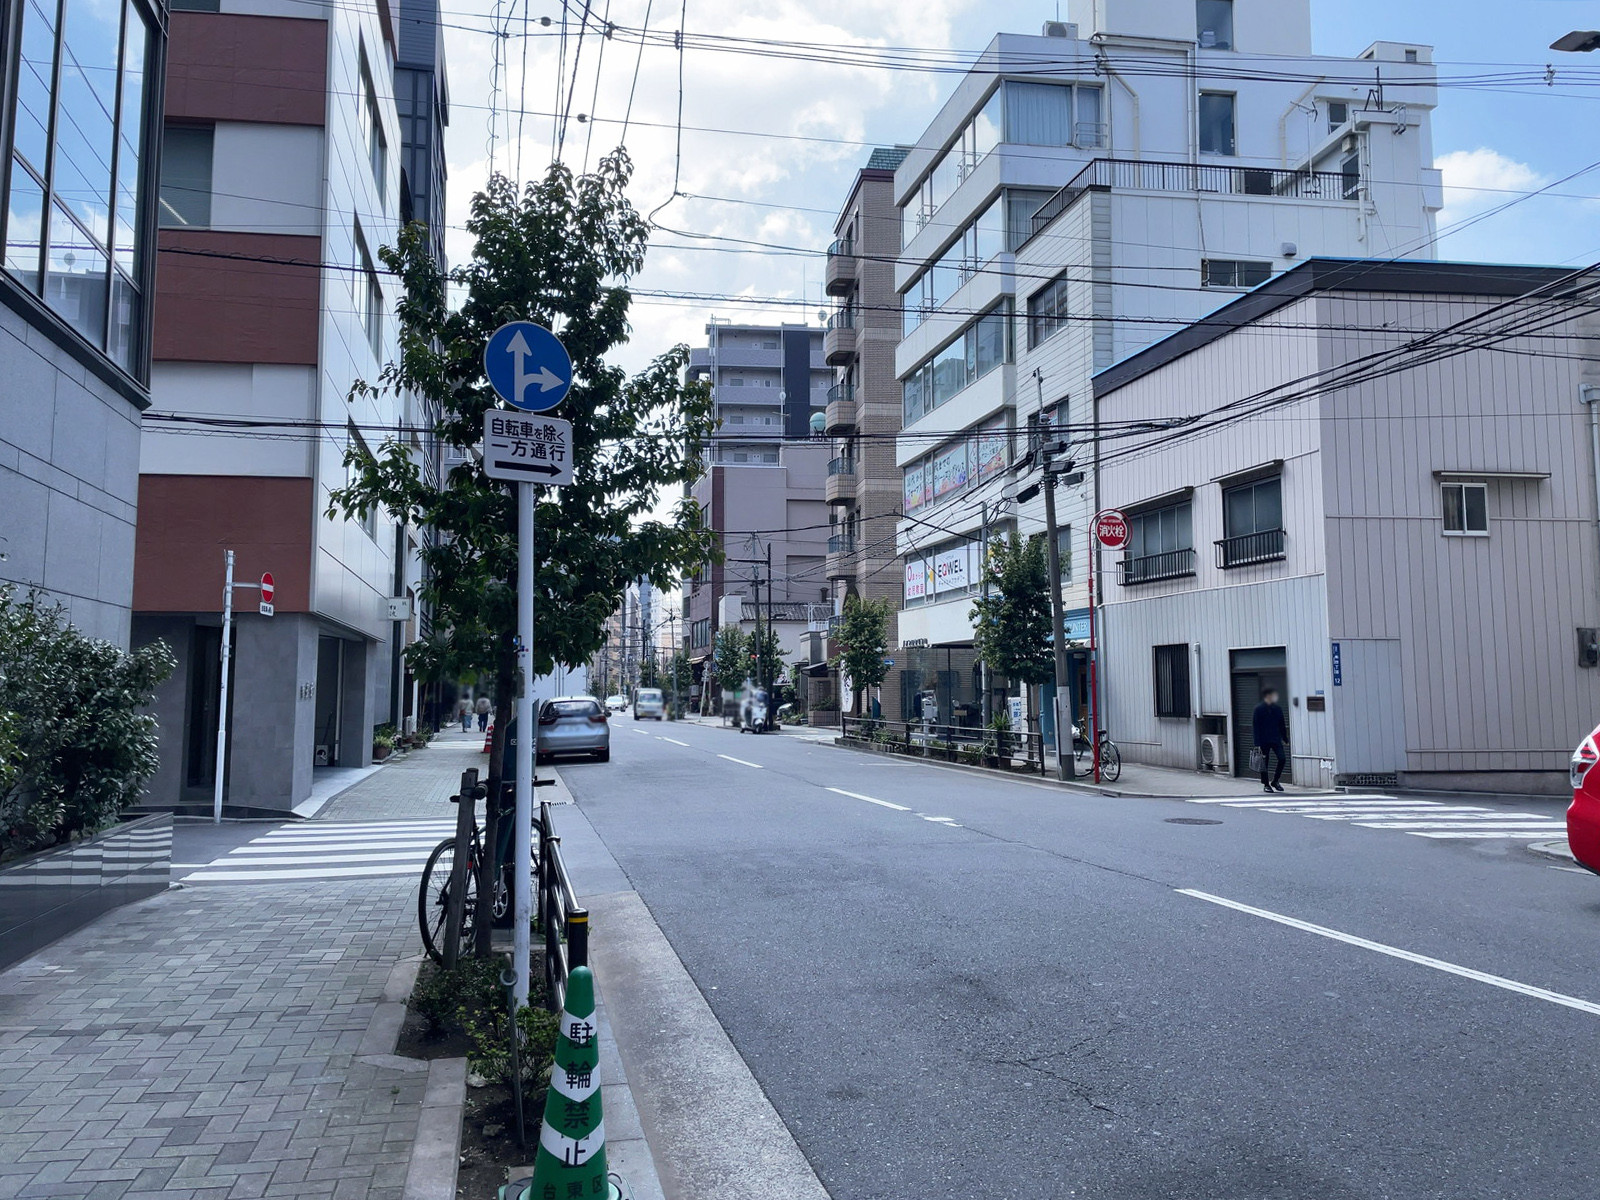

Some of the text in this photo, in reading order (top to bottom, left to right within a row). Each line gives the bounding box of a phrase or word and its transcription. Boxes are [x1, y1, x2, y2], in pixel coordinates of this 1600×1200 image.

[491, 418, 564, 443] 自転車を除く
[492, 440, 566, 462] 一方通行
[1099, 524, 1125, 538] 消火栓
[562, 1021, 594, 1169] 駐輪禁止
[543, 1173, 603, 1200] 台東区
